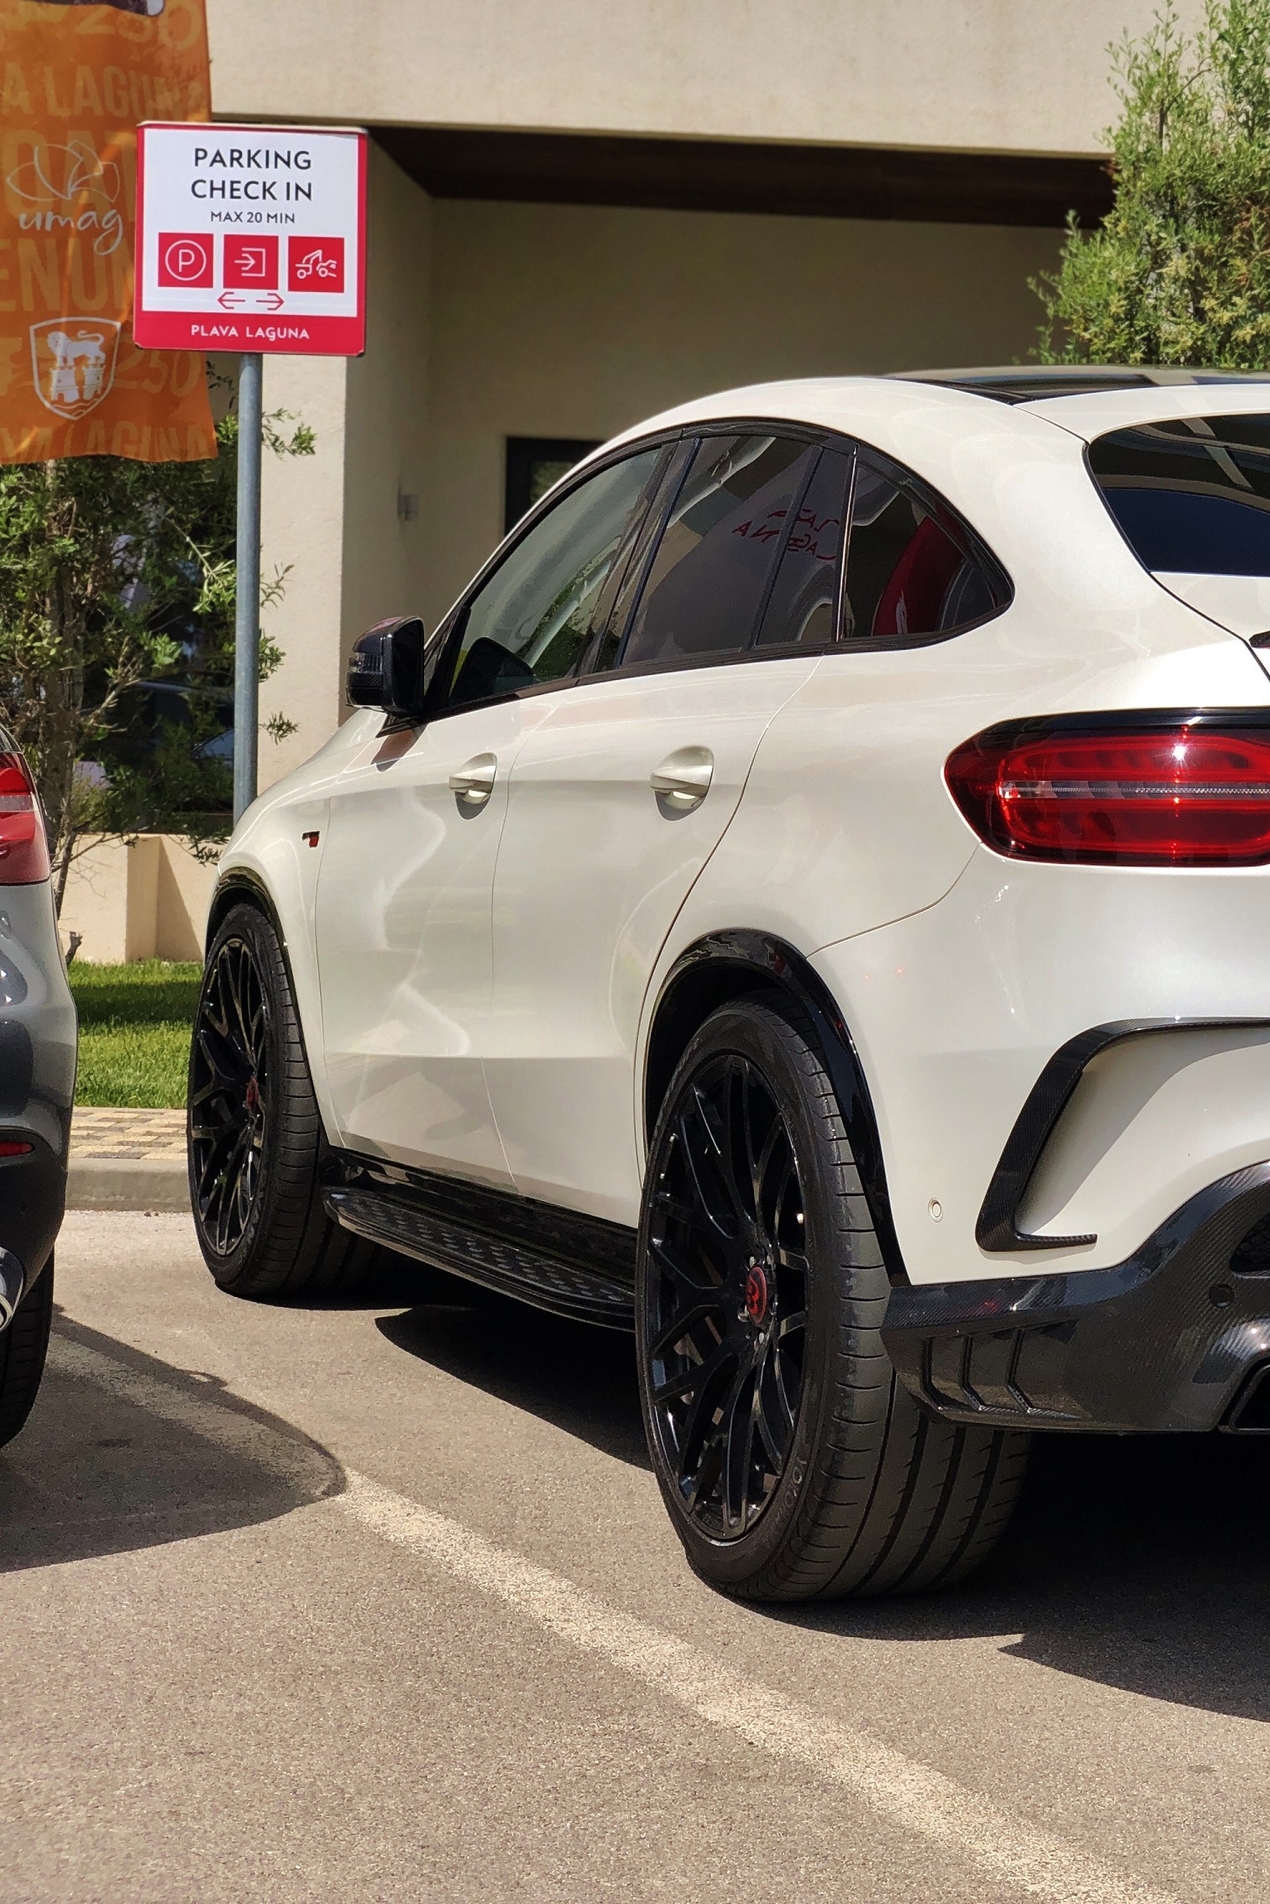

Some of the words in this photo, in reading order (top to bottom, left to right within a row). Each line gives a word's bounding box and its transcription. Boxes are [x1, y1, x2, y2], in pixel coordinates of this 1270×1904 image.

[194, 148, 312, 170] PARKING
[191, 179, 278, 201] CHECK
[286, 181, 312, 201] IN
[210, 211, 243, 223] MAX
[246, 211, 262, 224] 20
[267, 212, 295, 224] MIN
[19, 207, 123, 255] umag
[191, 324, 239, 337] PLAVA
[246, 326, 310, 341] LAGUNA
